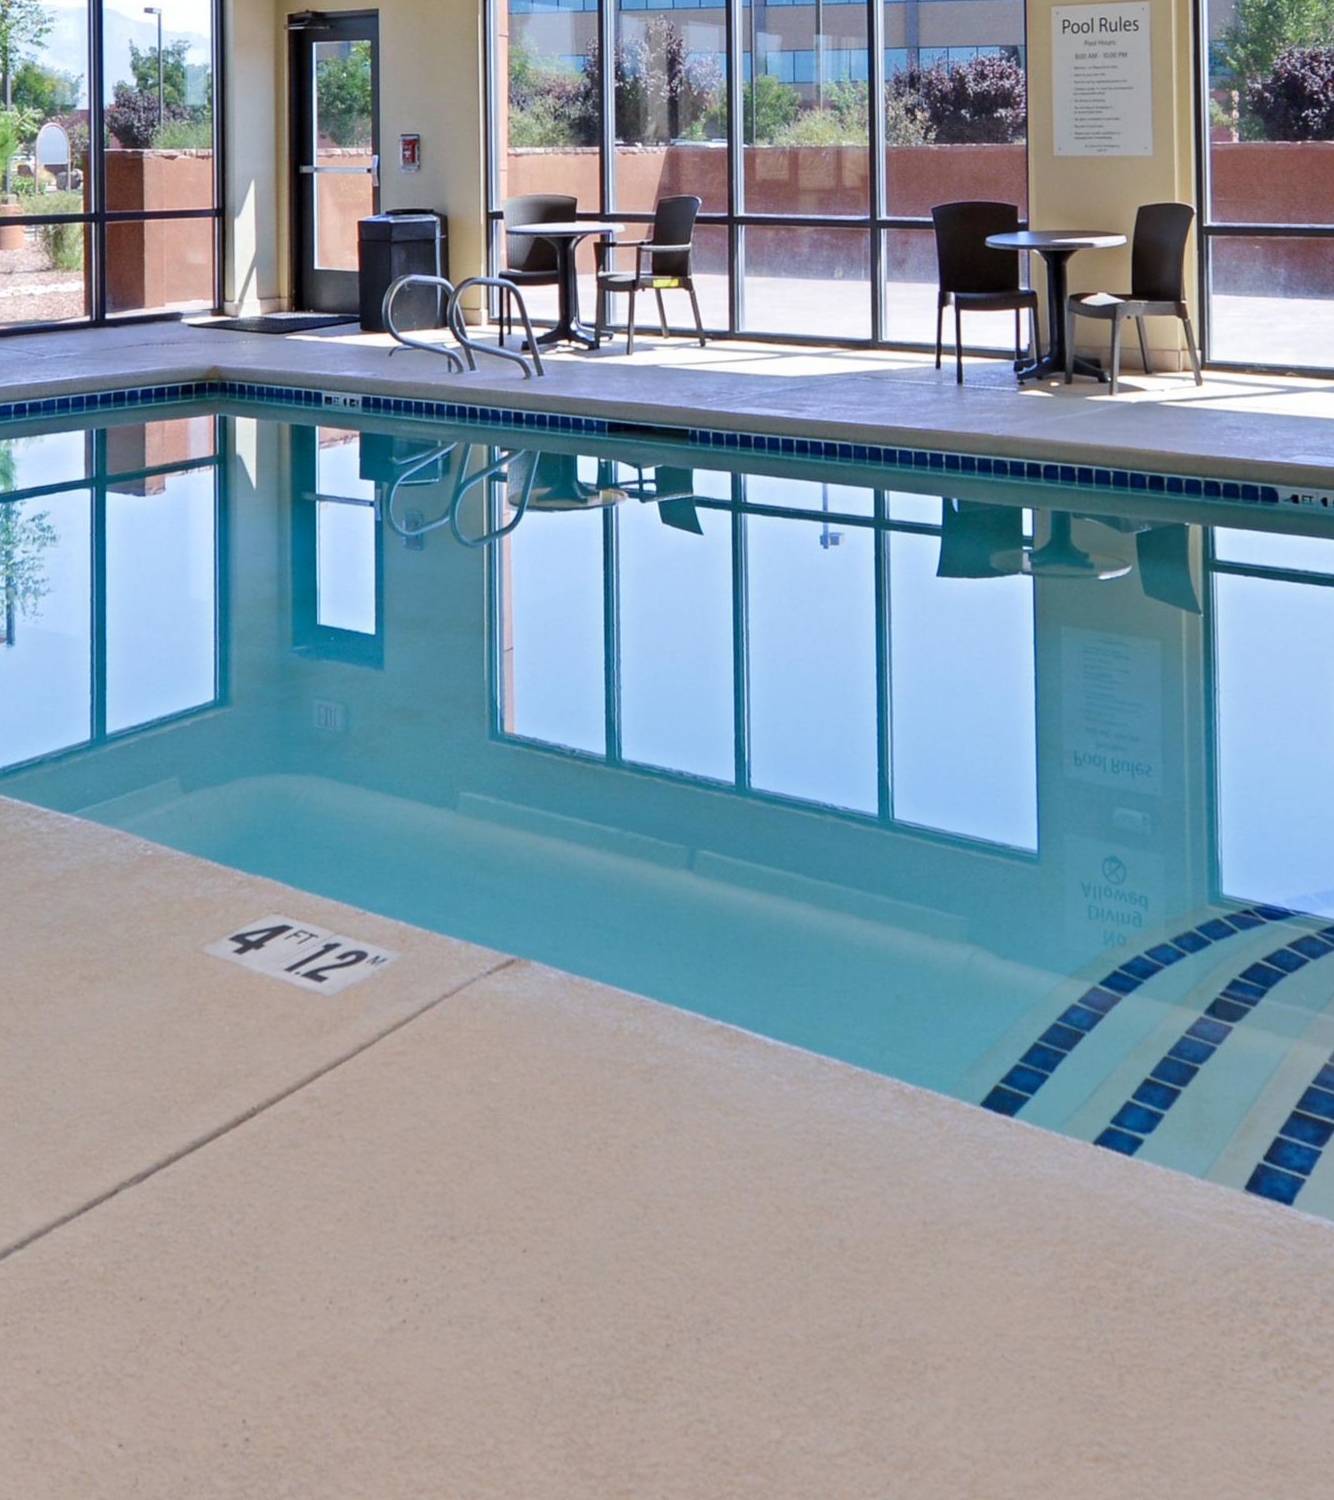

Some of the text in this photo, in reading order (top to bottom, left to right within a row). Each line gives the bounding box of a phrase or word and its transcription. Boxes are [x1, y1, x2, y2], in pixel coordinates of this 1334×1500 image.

[1062, 16, 1140, 35] Pool Rules
[228, 924, 294, 955] 4
[284, 929, 319, 945] FT
[366, 955, 390, 966] M
